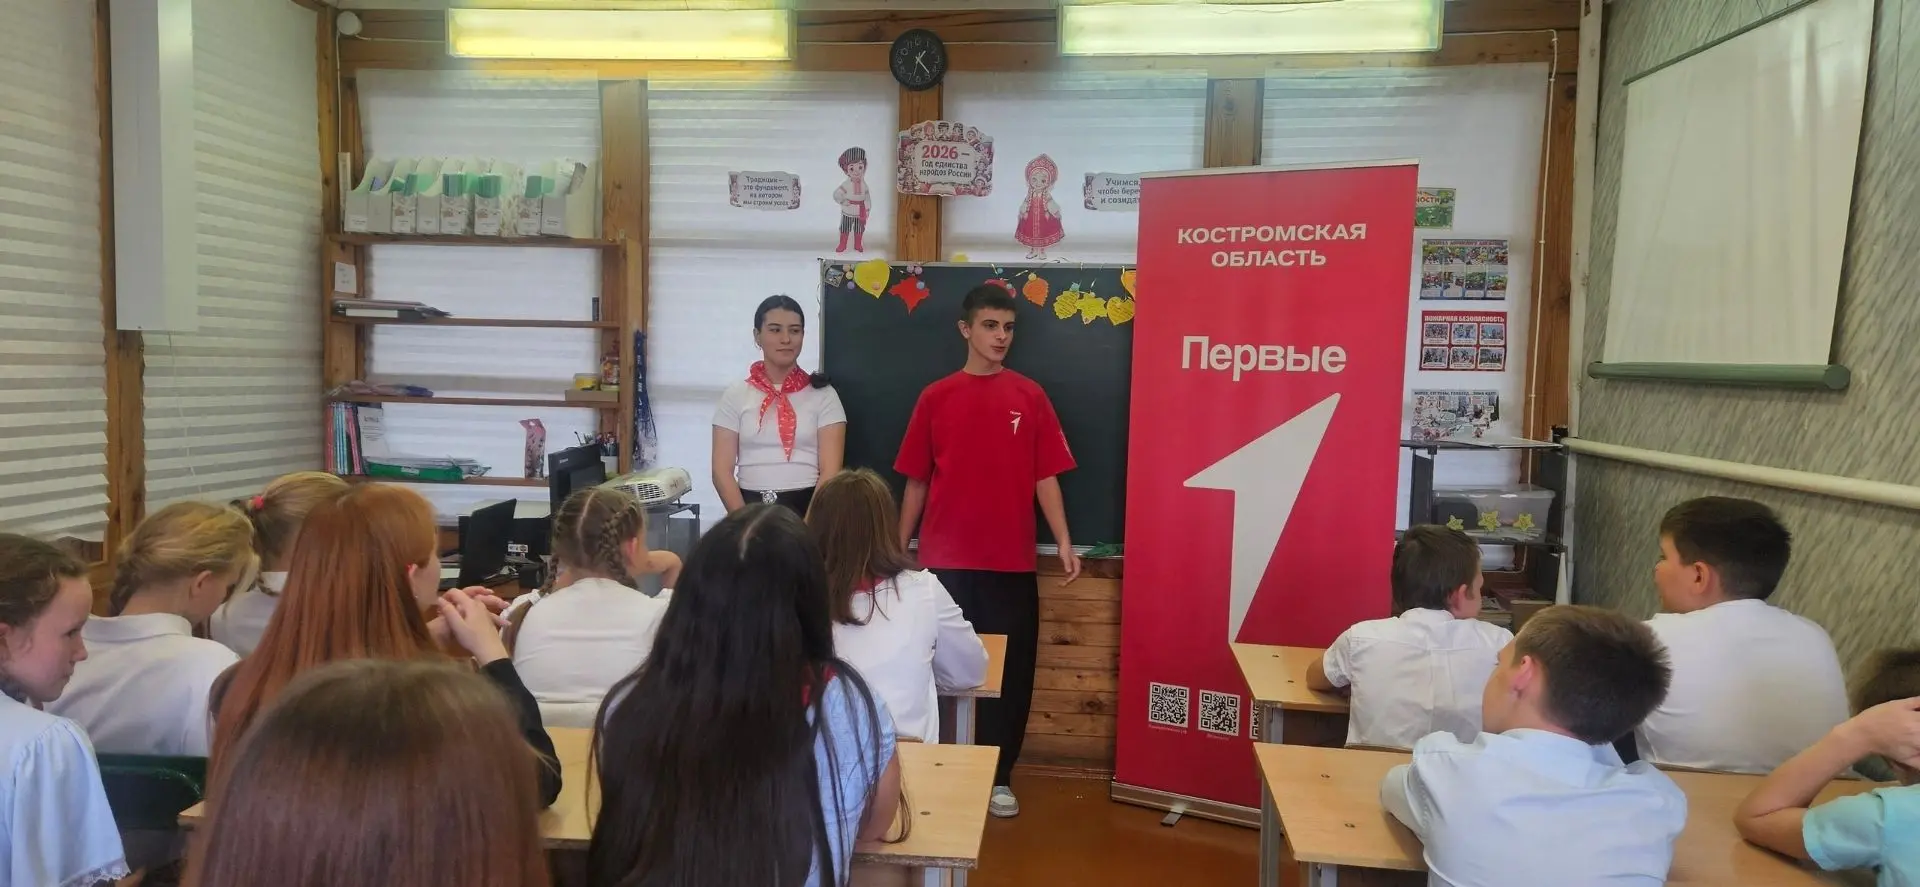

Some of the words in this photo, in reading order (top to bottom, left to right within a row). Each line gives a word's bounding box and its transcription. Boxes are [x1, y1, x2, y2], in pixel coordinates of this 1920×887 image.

[921, 145, 959, 159] 2026
[922, 160, 934, 168] Год
[935, 161, 968, 170] единства
[919, 169, 947, 177] народов
[947, 169, 972, 178] России
[1097, 187, 1120, 195] чтобы
[1177, 223, 1367, 244] КОСТРОМСКАЯ
[1211, 249, 1326, 267] ОБЛАСТЬ
[1181, 335, 1347, 382] Первые
